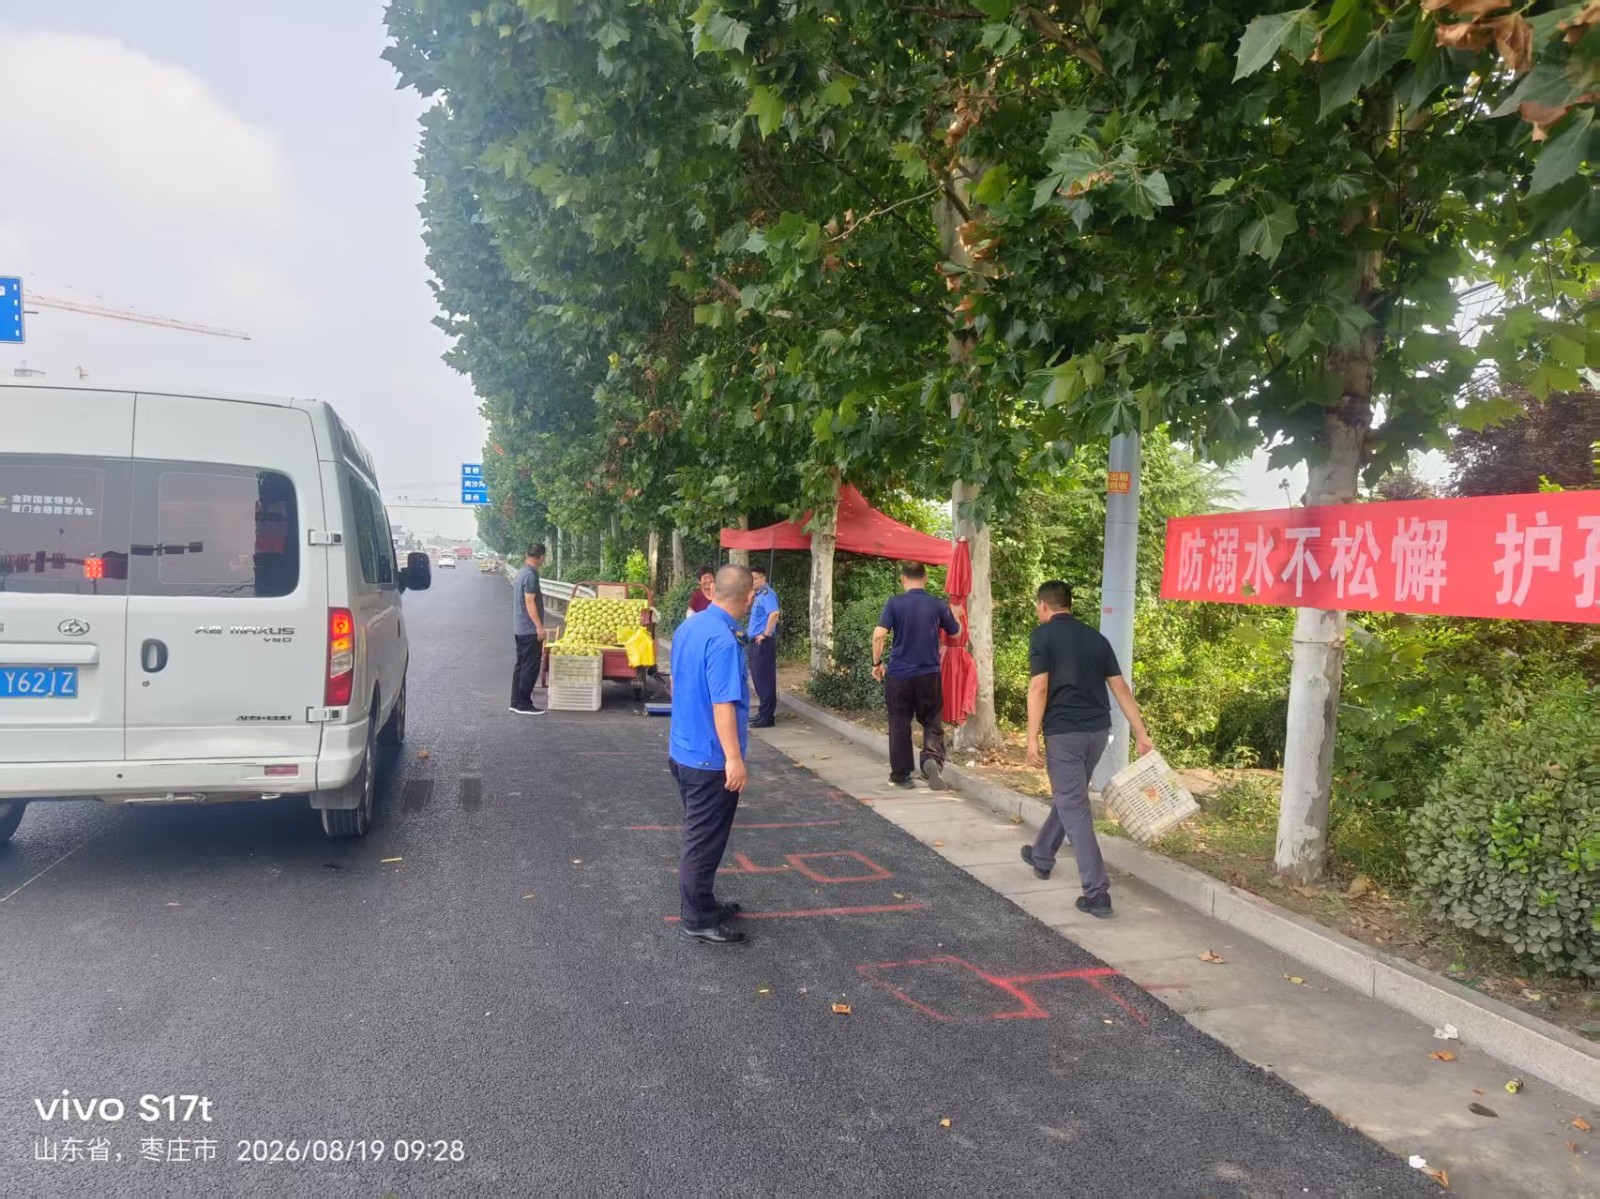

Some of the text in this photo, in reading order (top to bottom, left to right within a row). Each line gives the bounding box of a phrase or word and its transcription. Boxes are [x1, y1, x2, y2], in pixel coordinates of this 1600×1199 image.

[1177, 517, 1448, 603] 防溺水不松懈
[230, 626, 295, 635] MAXUS
